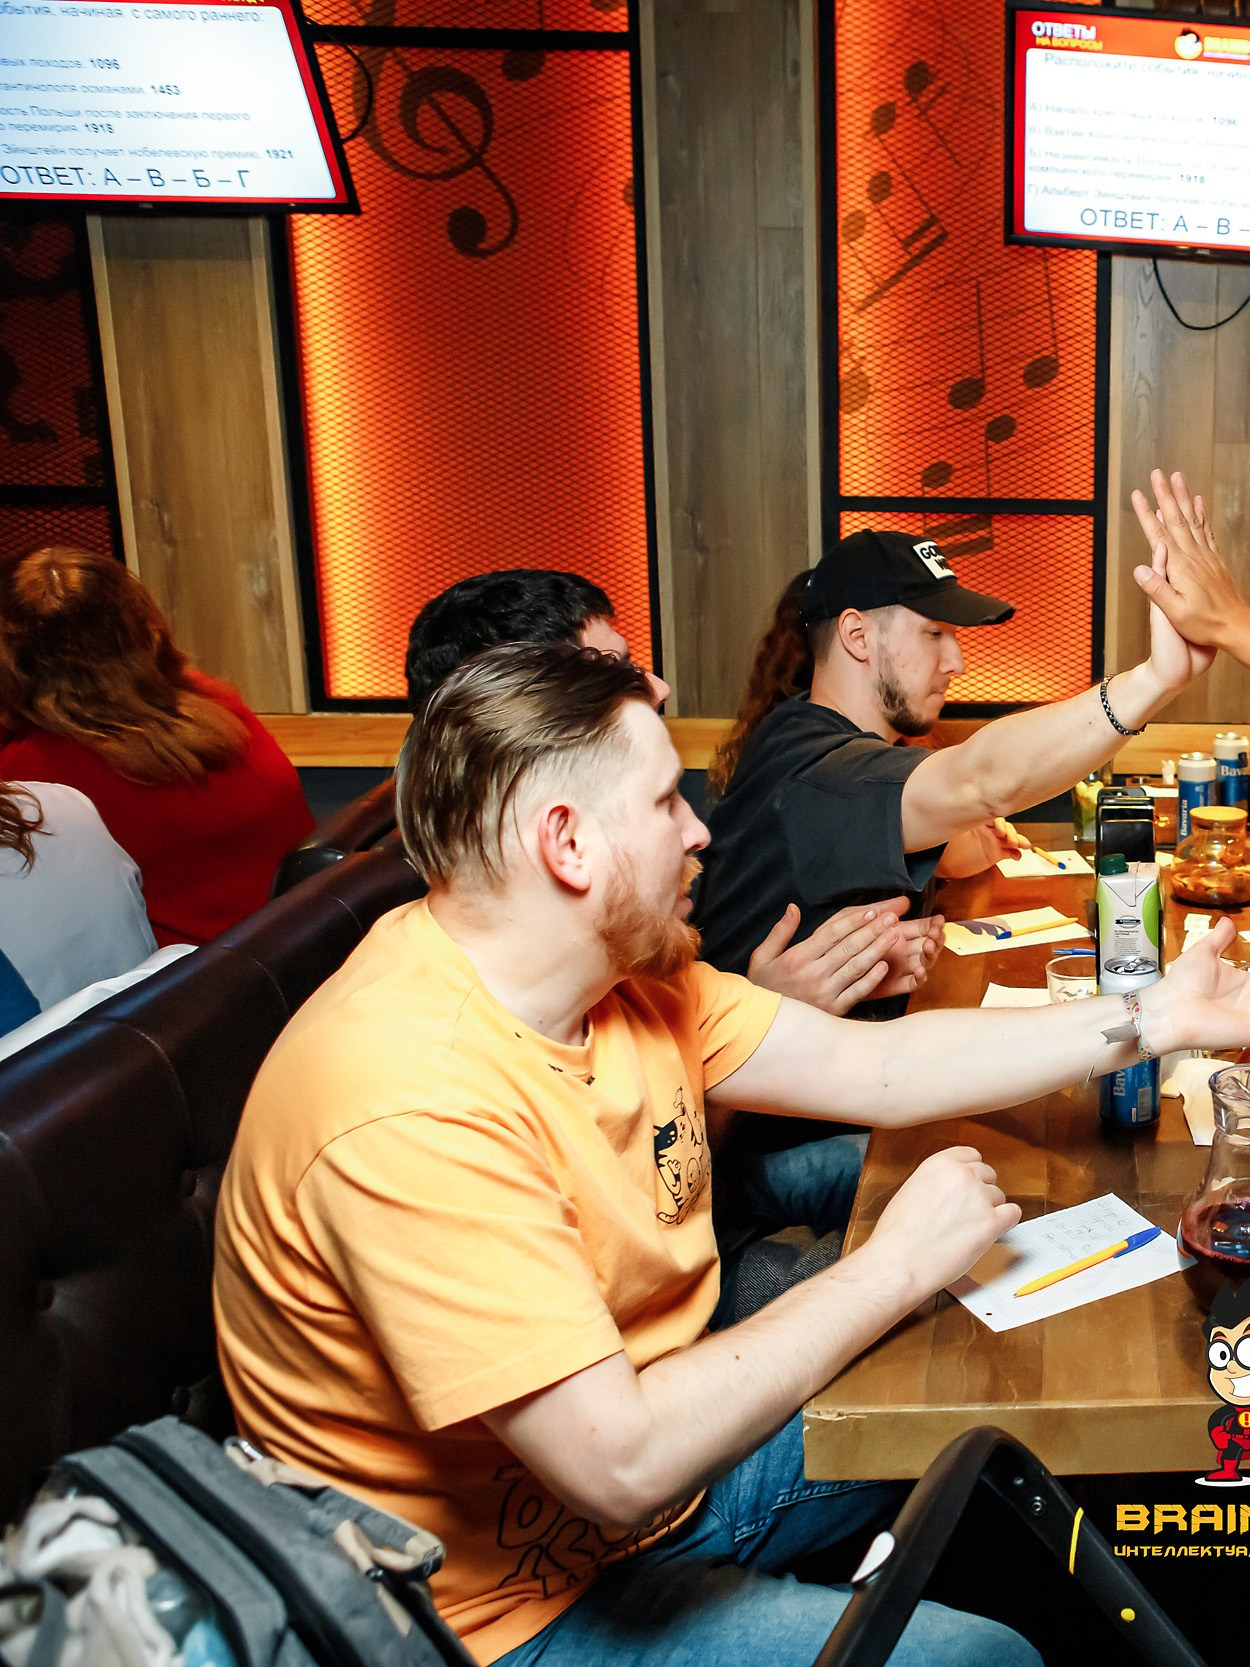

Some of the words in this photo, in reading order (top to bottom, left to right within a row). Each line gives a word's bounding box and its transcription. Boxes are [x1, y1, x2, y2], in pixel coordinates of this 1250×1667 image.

[144, 9, 197, 21] самого
[1031, 21, 1096, 40] ОТВЕТЫ
[88, 58, 120, 70] 1096
[150, 84, 182, 96] 1453
[264, 149, 295, 160] 1921
[0, 165, 97, 187] ОТВЕТ:
[104, 167, 122, 187] А
[146, 168, 166, 188] В
[192, 169, 212, 189] Б
[236, 170, 250, 189] Г
[1179, 174, 1206, 184] 1918
[1080, 207, 1166, 231] ОТВЕТ:
[1172, 214, 1189, 232] А
[1216, 216, 1232, 236] В
[1180, 800, 1188, 836] Bavaria
